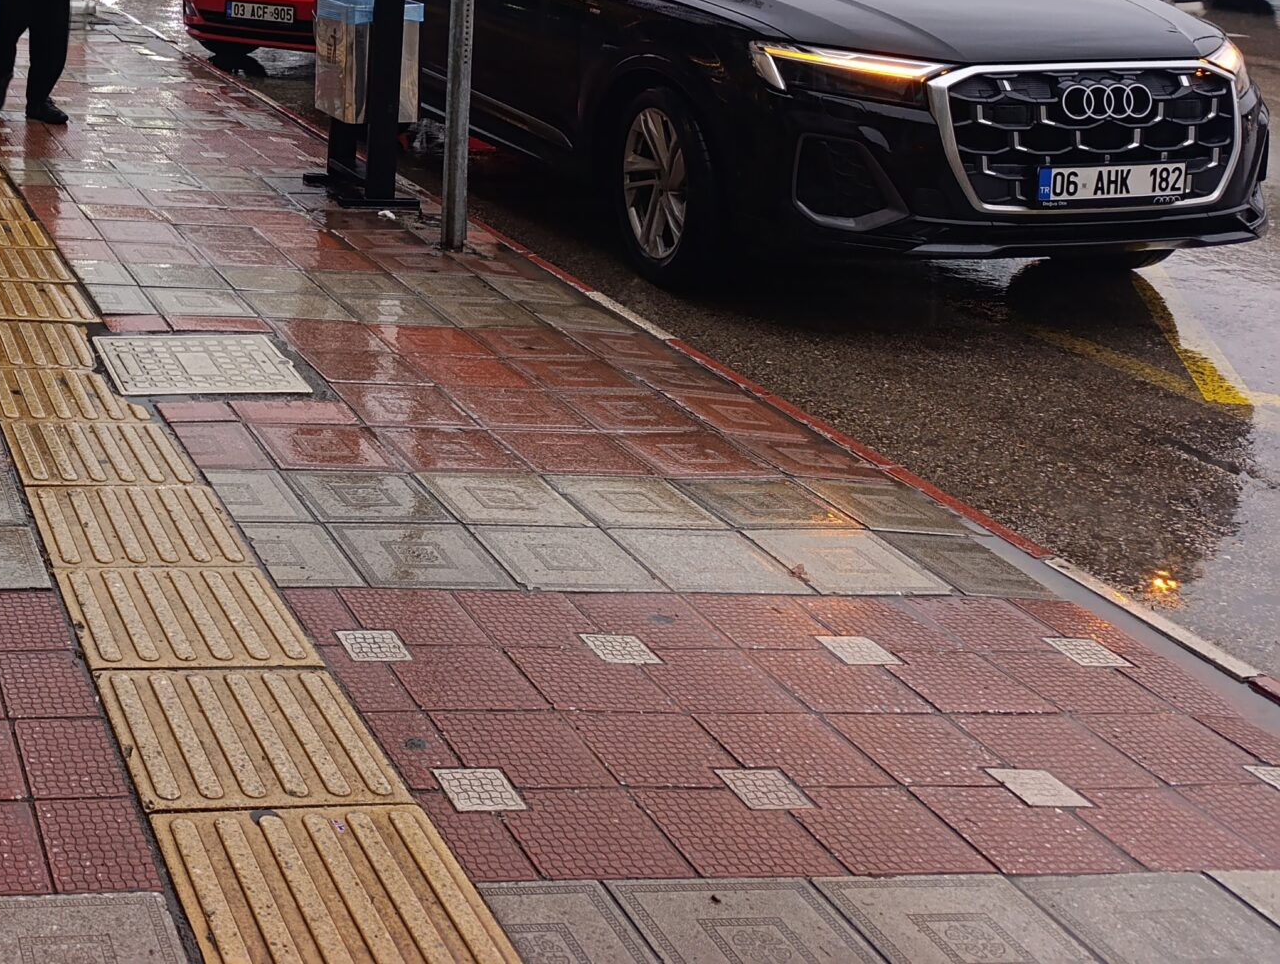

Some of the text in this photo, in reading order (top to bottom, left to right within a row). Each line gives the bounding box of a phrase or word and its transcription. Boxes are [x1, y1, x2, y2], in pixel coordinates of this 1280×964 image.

[233, 3, 293, 21] 03 ACF 905
[1039, 186, 1050, 194] TR
[1052, 167, 1183, 197] 06 AHK 182
